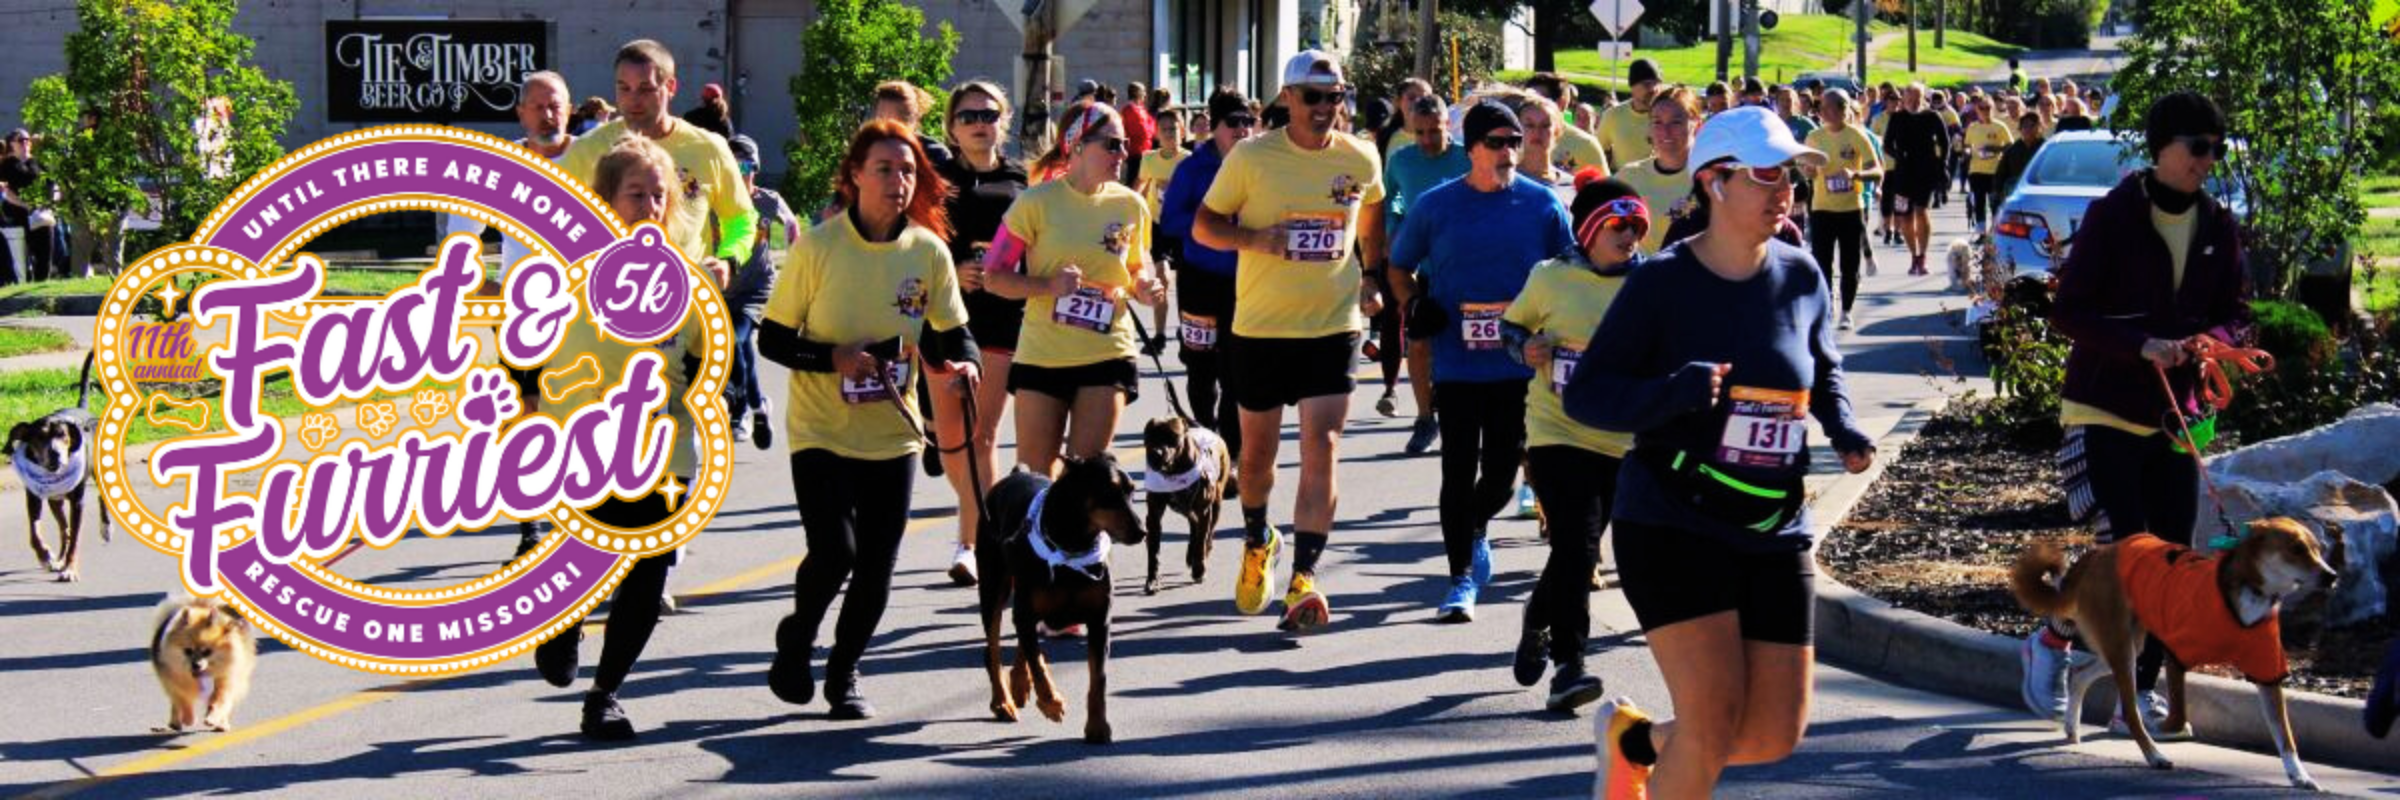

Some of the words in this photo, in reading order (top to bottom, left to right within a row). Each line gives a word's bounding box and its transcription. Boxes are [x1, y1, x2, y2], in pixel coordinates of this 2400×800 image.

[360, 82, 418, 112] BEER
[1297, 232, 1336, 249] 270
[1069, 297, 1103, 319] 271
[1185, 326, 1210, 344] 291
[1471, 323, 1496, 339] 26
[1748, 421, 1790, 449] 131
